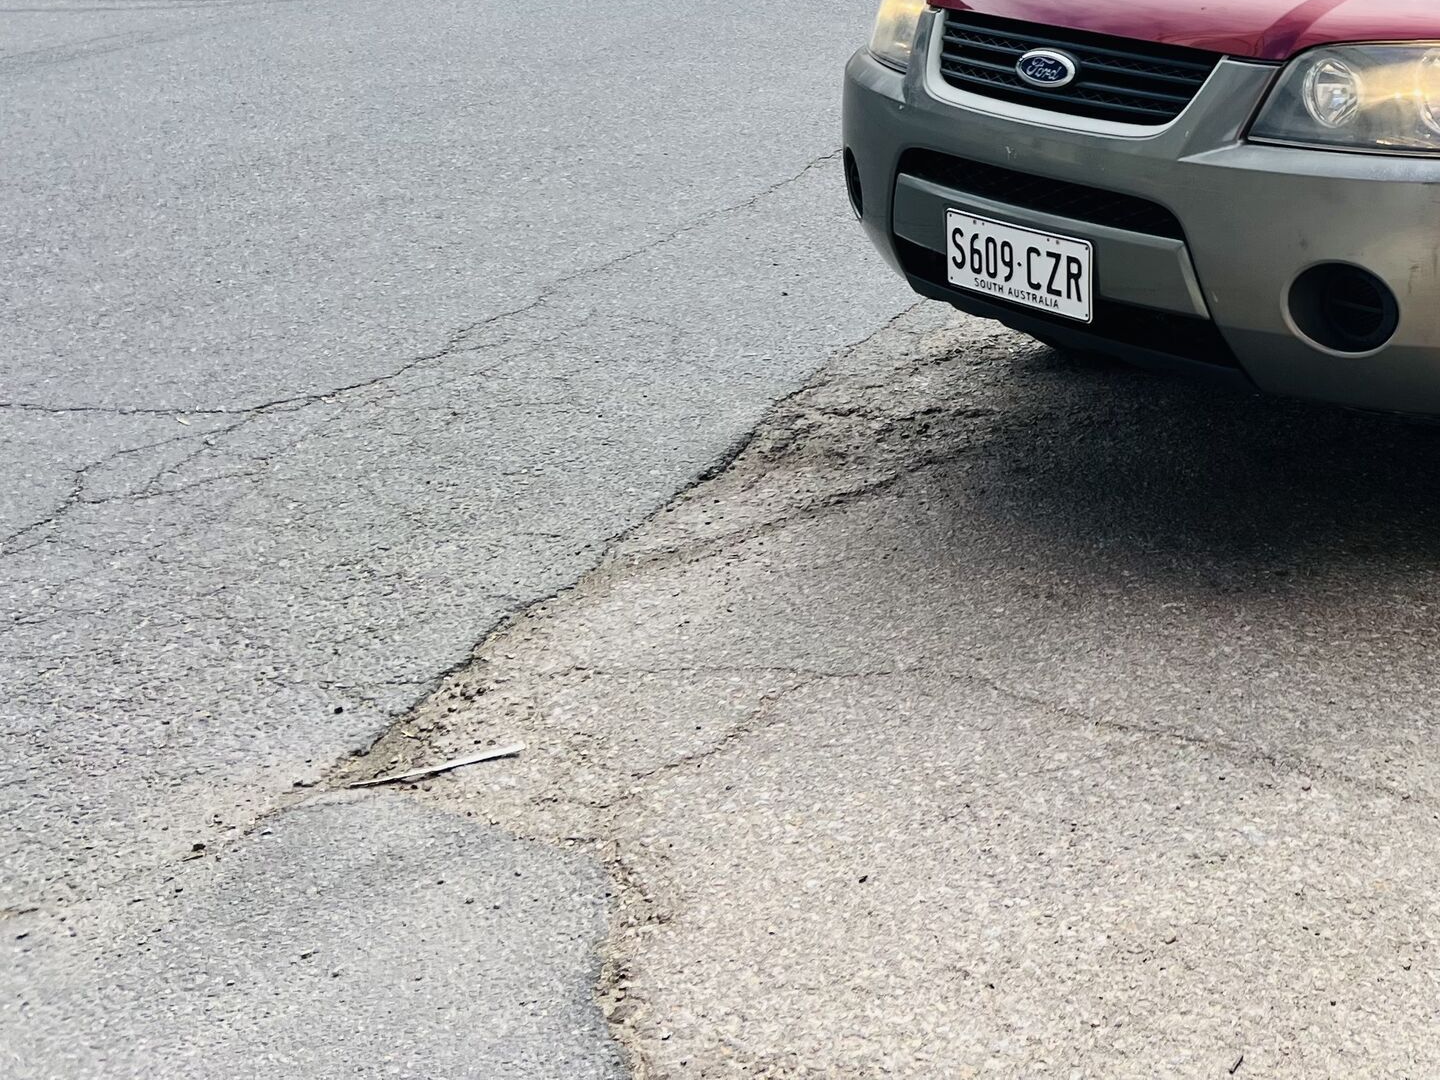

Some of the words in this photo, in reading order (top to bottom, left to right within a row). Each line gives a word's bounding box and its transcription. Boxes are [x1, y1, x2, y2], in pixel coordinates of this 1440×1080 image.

[1026, 57, 1062, 81] Ford
[974, 277, 1004, 295] SOUTH
[1007, 287, 1059, 309] AUSTRALIA
